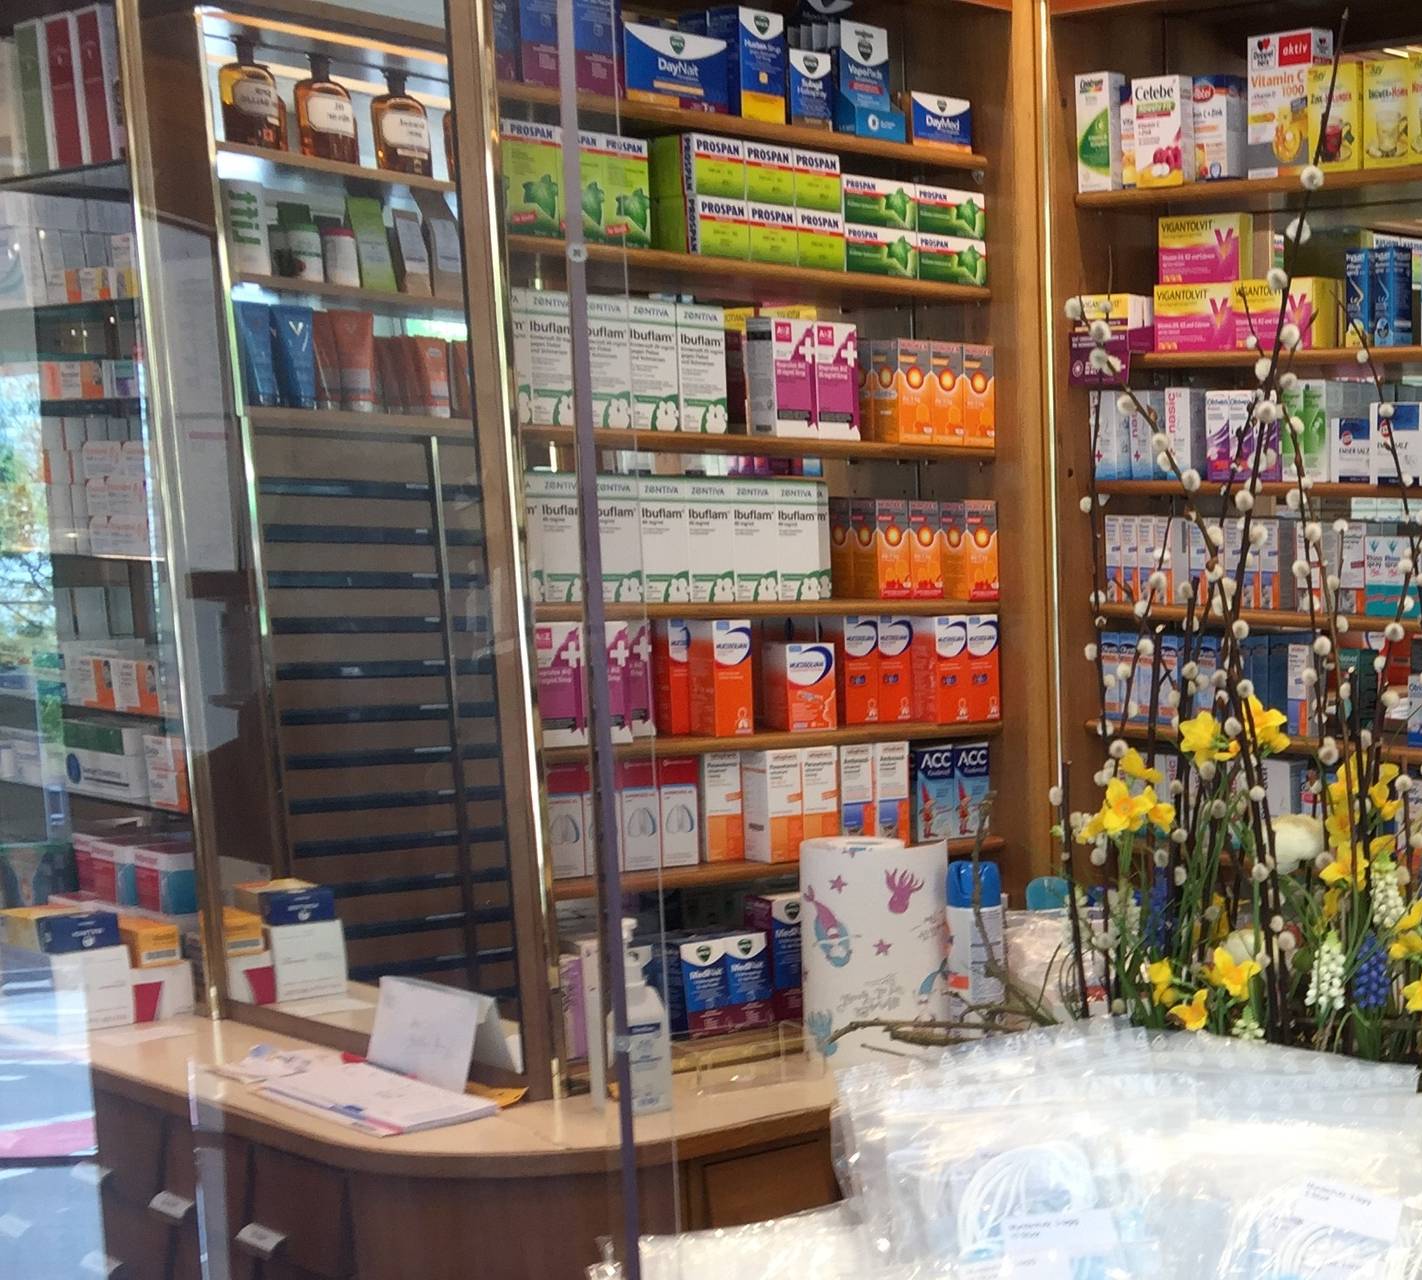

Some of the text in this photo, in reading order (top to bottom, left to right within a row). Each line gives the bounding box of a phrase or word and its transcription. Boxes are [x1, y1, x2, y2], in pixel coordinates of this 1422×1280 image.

[1283, 43, 1308, 57] aktiv
[658, 57, 699, 79] DayNait
[1251, 72, 1293, 88] Vitamin
[1282, 84, 1304, 97] 1000
[926, 115, 961, 131] DayMed
[510, 124, 553, 140] PROSPAN
[606, 139, 643, 154] PROSPAN
[696, 140, 739, 157] PROSPAN
[748, 147, 790, 164] PROSPAN
[796, 156, 837, 171] PROSPAN
[846, 179, 876, 191] PROSPAN
[919, 190, 947, 201] PROSPAN
[702, 202, 745, 217] PROSPAN
[752, 208, 793, 224] PROSPAN
[801, 214, 840, 229] PROSPAN
[1161, 219, 1212, 233] VIGANTOLVIT
[848, 229, 878, 240] PROSPAN
[920, 238, 949, 249] PROSPAN
[1157, 287, 1208, 300] VIGANTOLVIT
[630, 329, 671, 343] Ibuflam
[680, 334, 722, 348] Ibuflam
[642, 507, 680, 519] Ibuflam
[689, 508, 728, 520] Ibuflam
[734, 509, 772, 521] Ibuflam
[778, 510, 816, 522] Ibuflam
[921, 753, 951, 769] ACC
[957, 750, 987, 766] ACC
